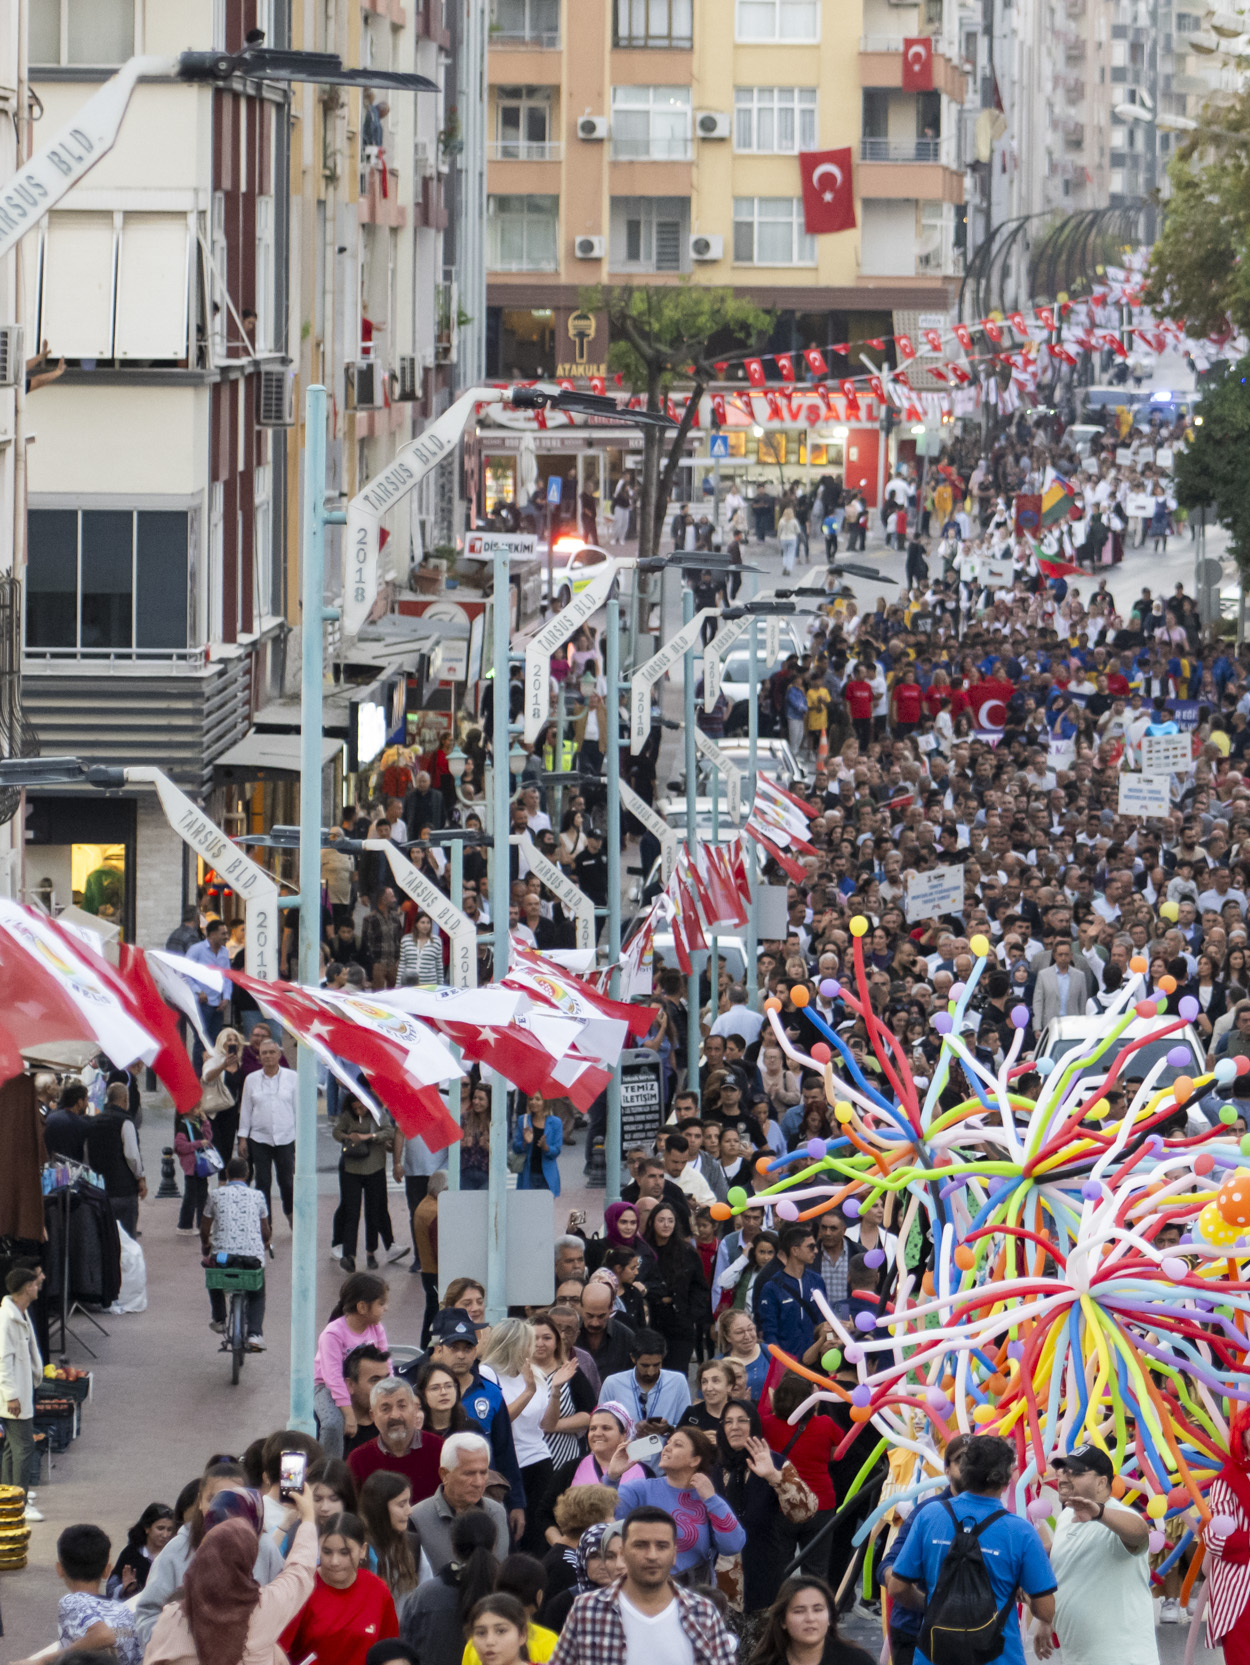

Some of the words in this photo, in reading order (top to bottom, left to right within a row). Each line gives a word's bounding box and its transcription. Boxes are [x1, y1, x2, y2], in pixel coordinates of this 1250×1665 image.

[556, 364, 607, 377] ATAKULE
[363, 462, 414, 511] TARSUS
[354, 528, 368, 603] 2018
[538, 615, 574, 651] TARSUS
[642, 653, 671, 682] TARSUS
[532, 665, 542, 718] 2018
[637, 692, 645, 736] 2018
[629, 797, 653, 821] TARSUS
[179, 809, 227, 858] TARSUS
[401, 871, 439, 908] TARSUS
[534, 860, 564, 890] TARSUS
[582, 919, 590, 948] 201
[461, 947, 470, 988] 201
[622, 1093, 657, 1104] İLETİŞİM
[624, 1083, 655, 1093] TEMİZ
